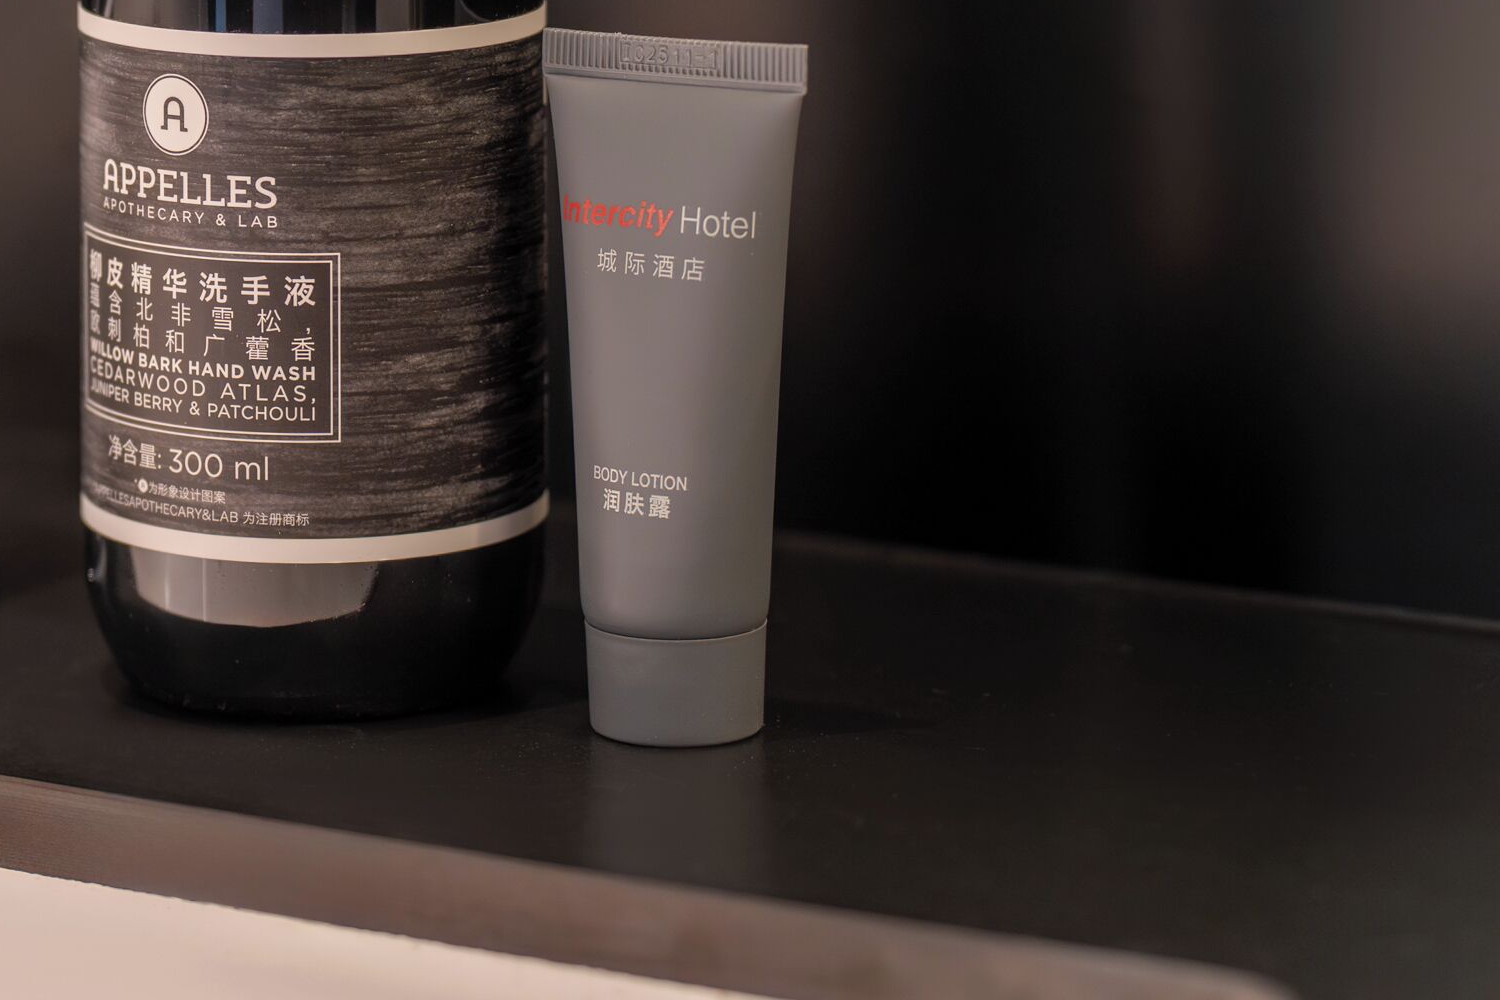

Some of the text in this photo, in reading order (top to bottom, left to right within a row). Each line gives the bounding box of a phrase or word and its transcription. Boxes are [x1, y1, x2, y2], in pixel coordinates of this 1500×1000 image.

[160, 96, 188, 133] A
[103, 158, 278, 210] APPELLES
[103, 196, 279, 229] APOTHECARY & LAB
[563, 193, 757, 239] Intercity Hotel
[89, 248, 317, 308] 柳皮精华洗手液
[597, 248, 706, 282] 城际酒店
[90, 337, 316, 381] WILLOW BARK HAND WASH
[90, 357, 317, 405] CEDARWOOD ATLAS,
[90, 378, 316, 422] JUNIPER BERRY & PATCHOULI
[169, 448, 223, 478] 300
[234, 456, 269, 481] ml
[593, 465, 688, 491] BODY LOTION
[243, 511, 310, 527] 为注册商标
[603, 488, 672, 519] 润肤露
